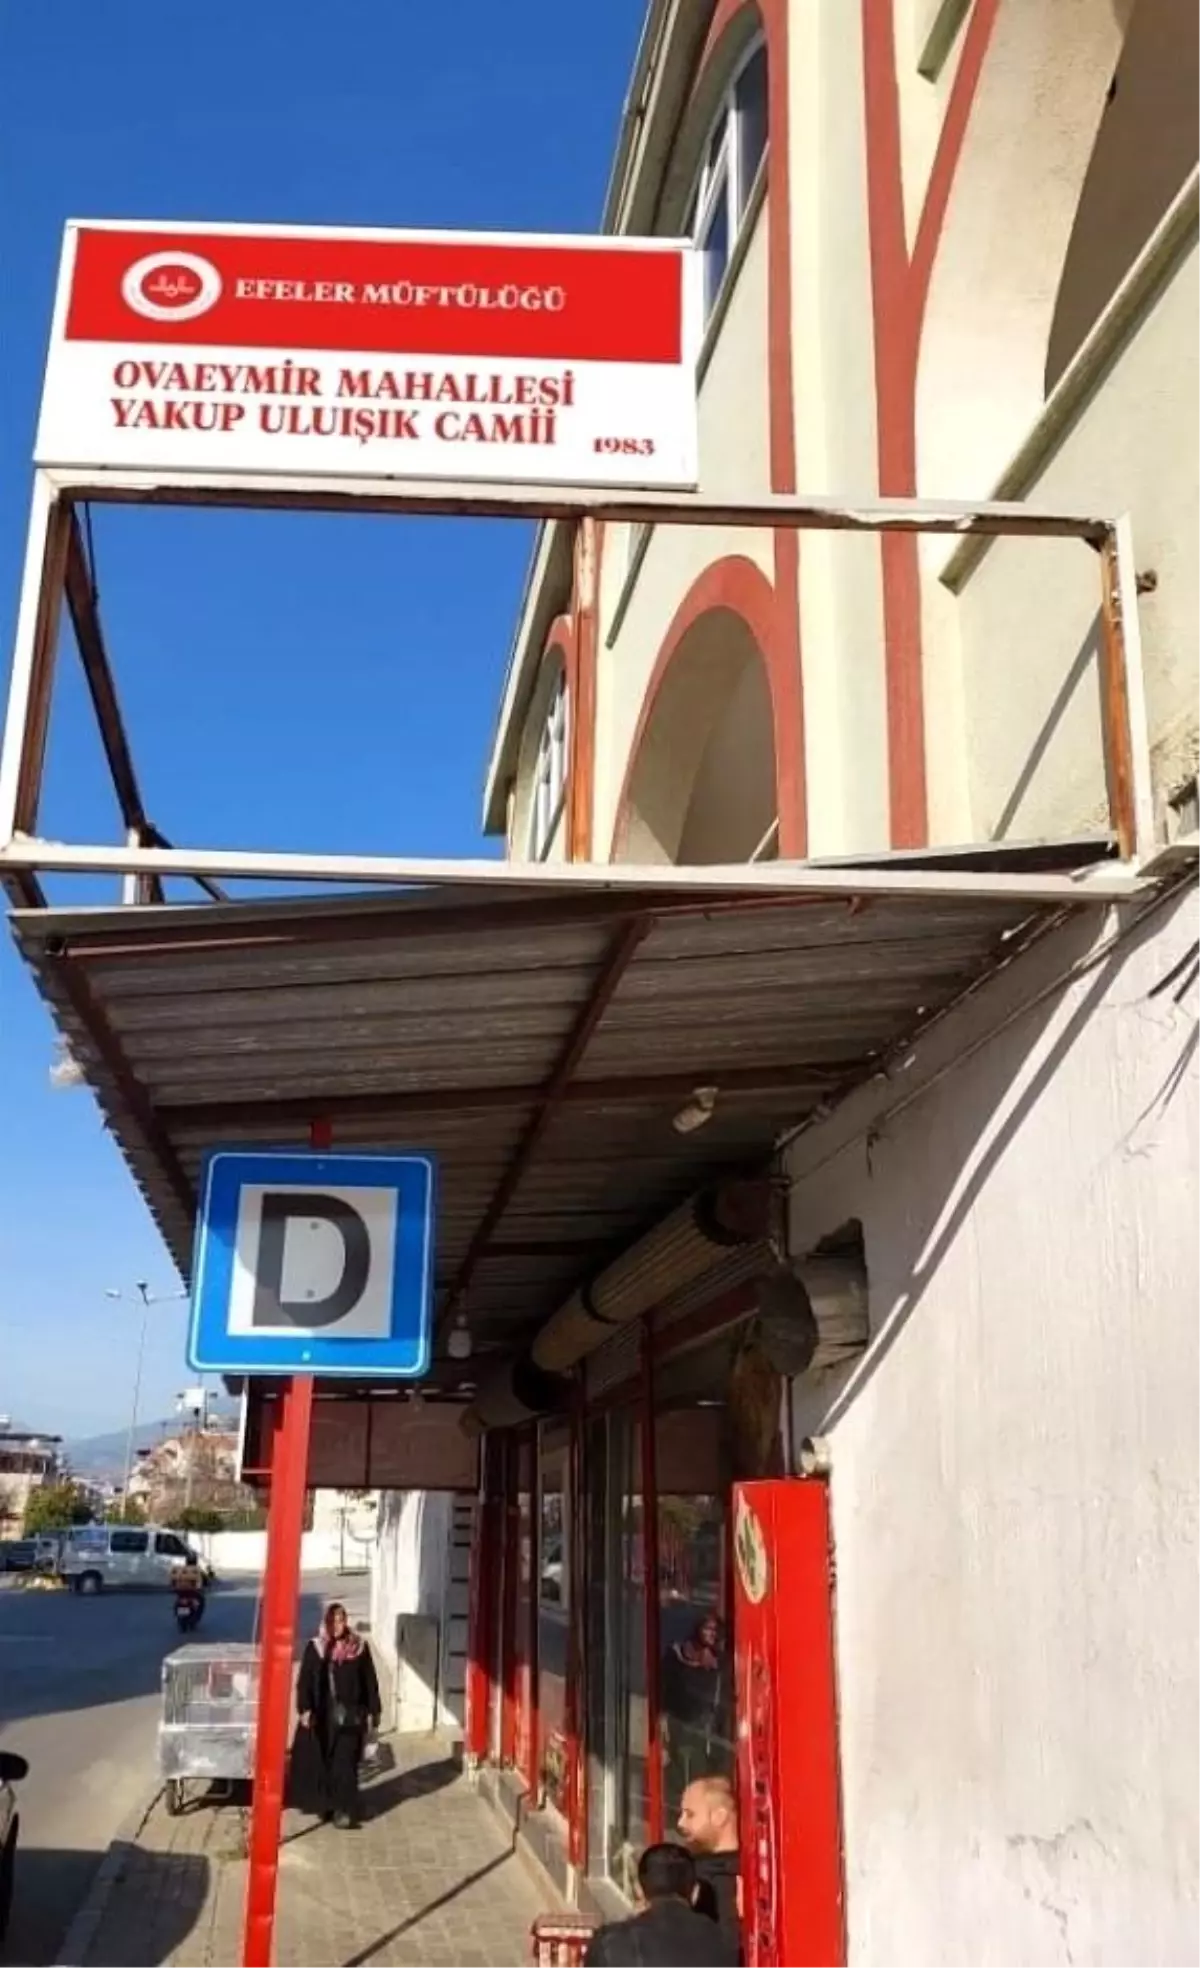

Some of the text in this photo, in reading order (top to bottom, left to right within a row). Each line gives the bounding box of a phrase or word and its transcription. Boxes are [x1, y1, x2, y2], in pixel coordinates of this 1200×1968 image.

[235, 279, 567, 312] EFELER MÜFTÜLÜĞÜ
[112, 359, 576, 407] OVAEYMİR MAHALLESİ
[110, 398, 557, 445] YAKUP ULUIŞIK CAMİİ
[593, 437, 656, 456] 1983
[250, 1191, 372, 1328] D
